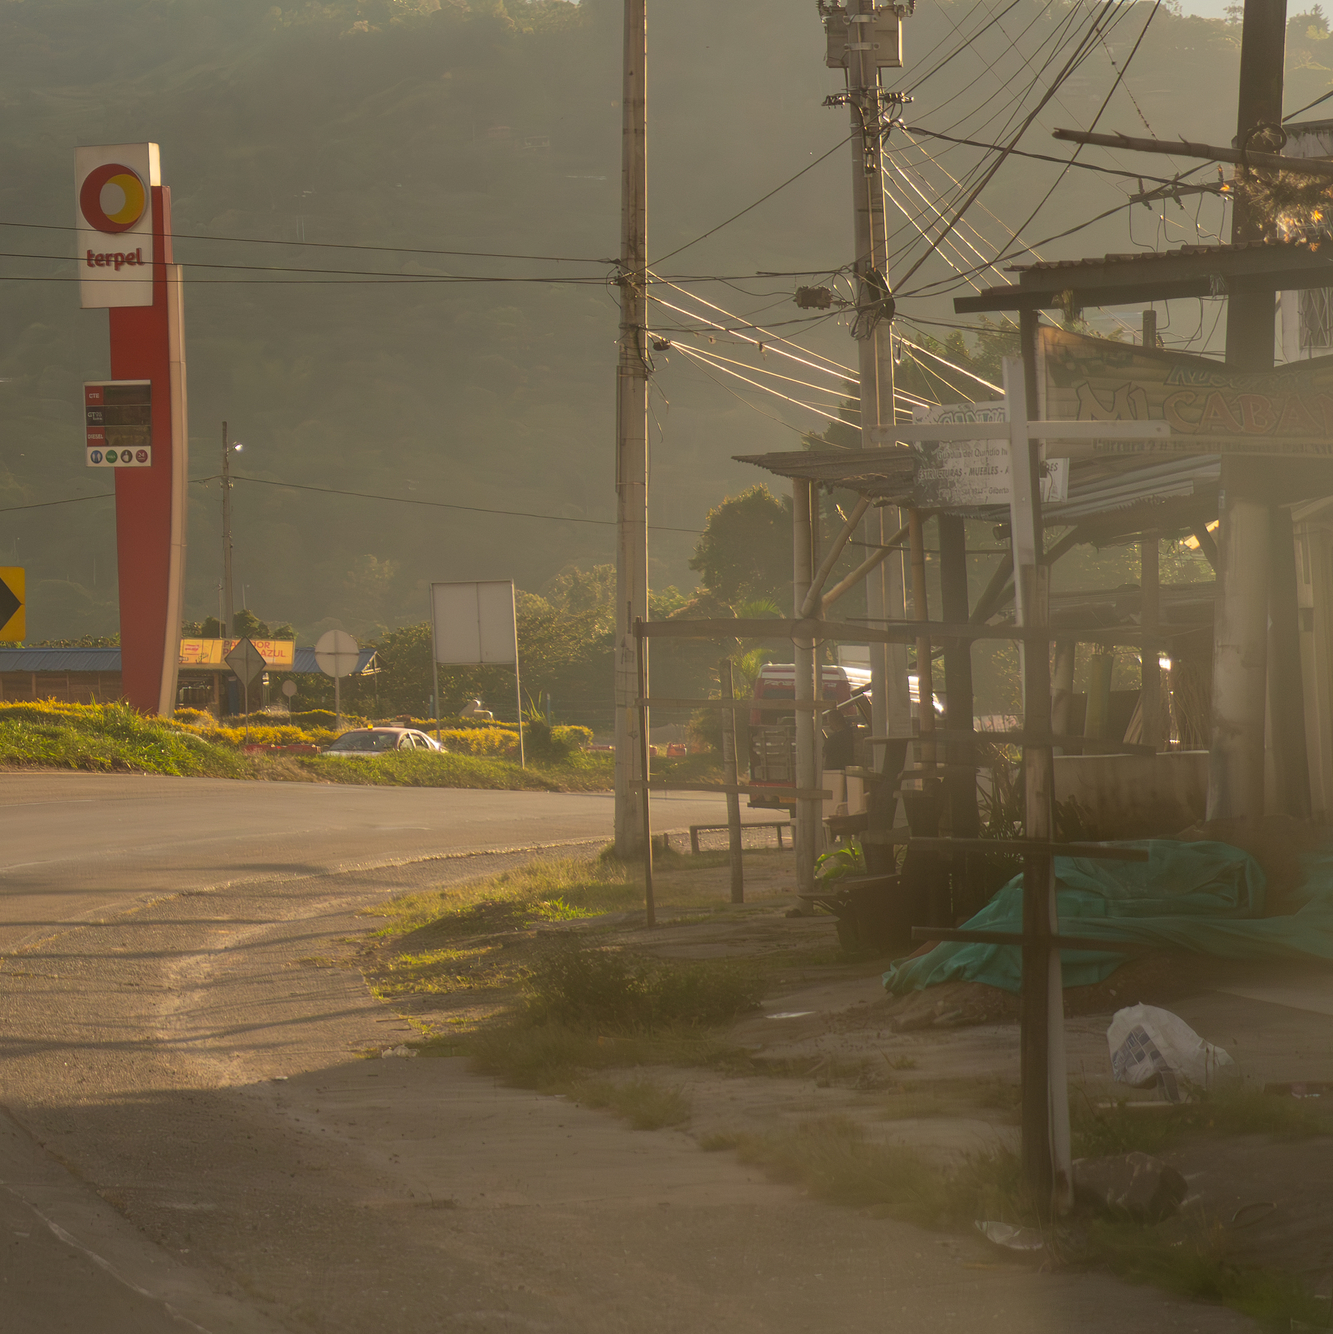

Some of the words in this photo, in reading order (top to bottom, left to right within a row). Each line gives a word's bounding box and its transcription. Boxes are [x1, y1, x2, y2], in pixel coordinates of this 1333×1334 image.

[87, 248, 143, 271] terpel
[968, 465, 999, 477] MUEBLES
[223, 640, 271, 649] PADOR
[261, 649, 286, 657] AZUL
